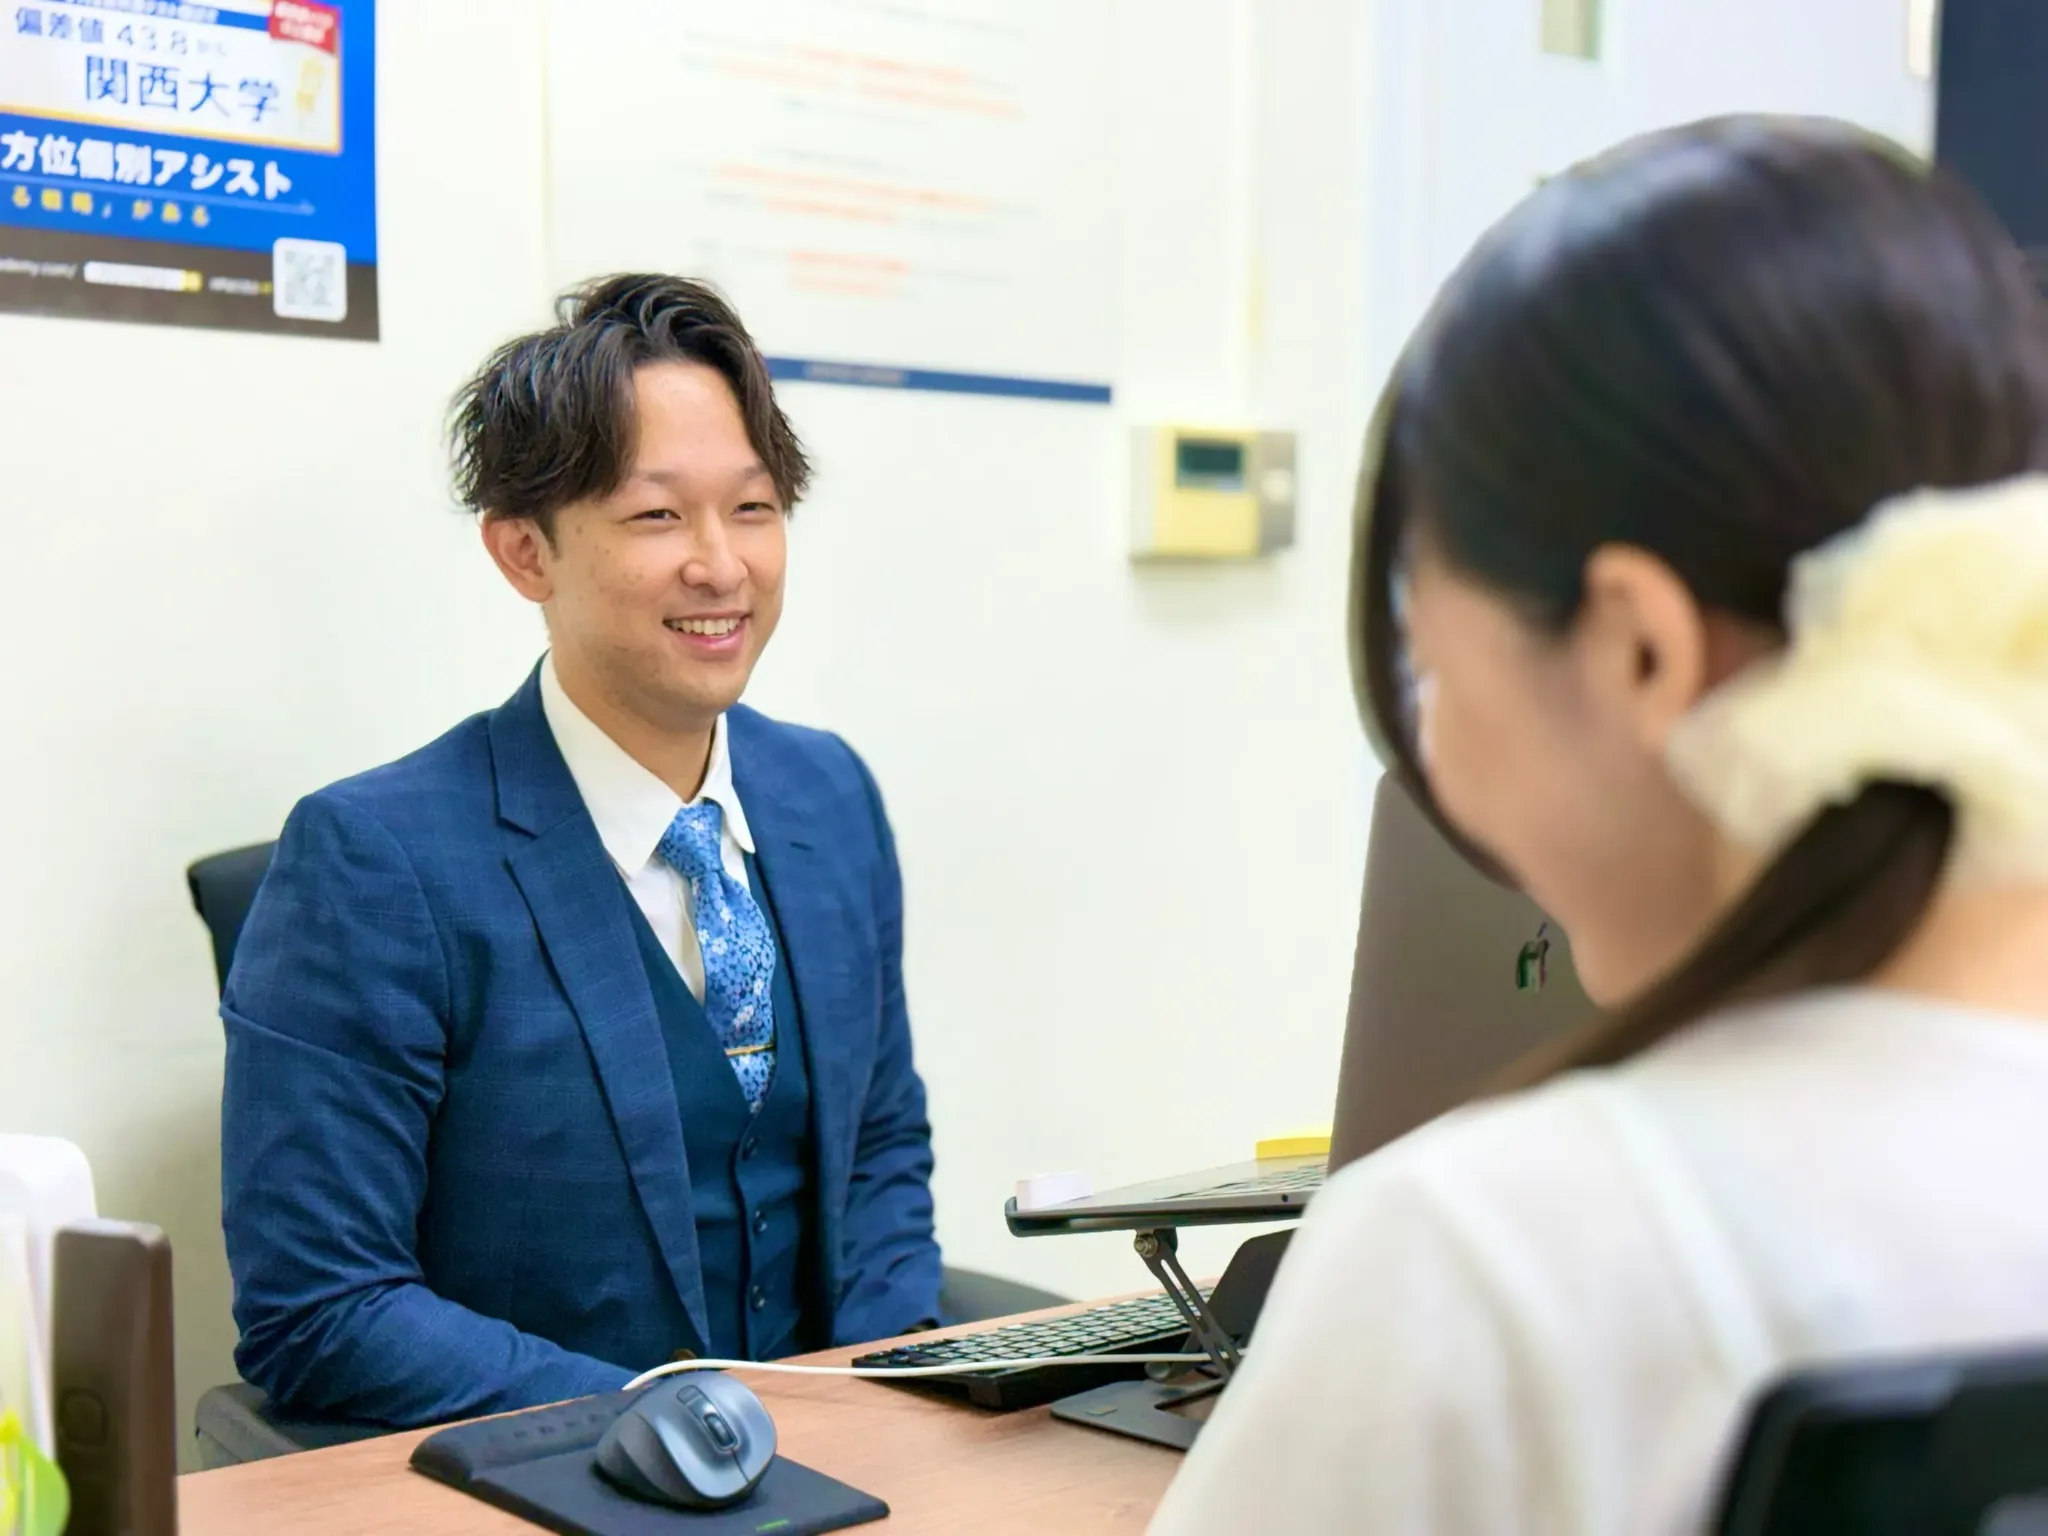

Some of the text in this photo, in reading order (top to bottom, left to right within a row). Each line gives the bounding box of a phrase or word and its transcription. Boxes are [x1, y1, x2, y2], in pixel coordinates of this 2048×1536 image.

[86, 54, 280, 122] 関西大学
[0, 130, 292, 201] 方位個別アシスト
